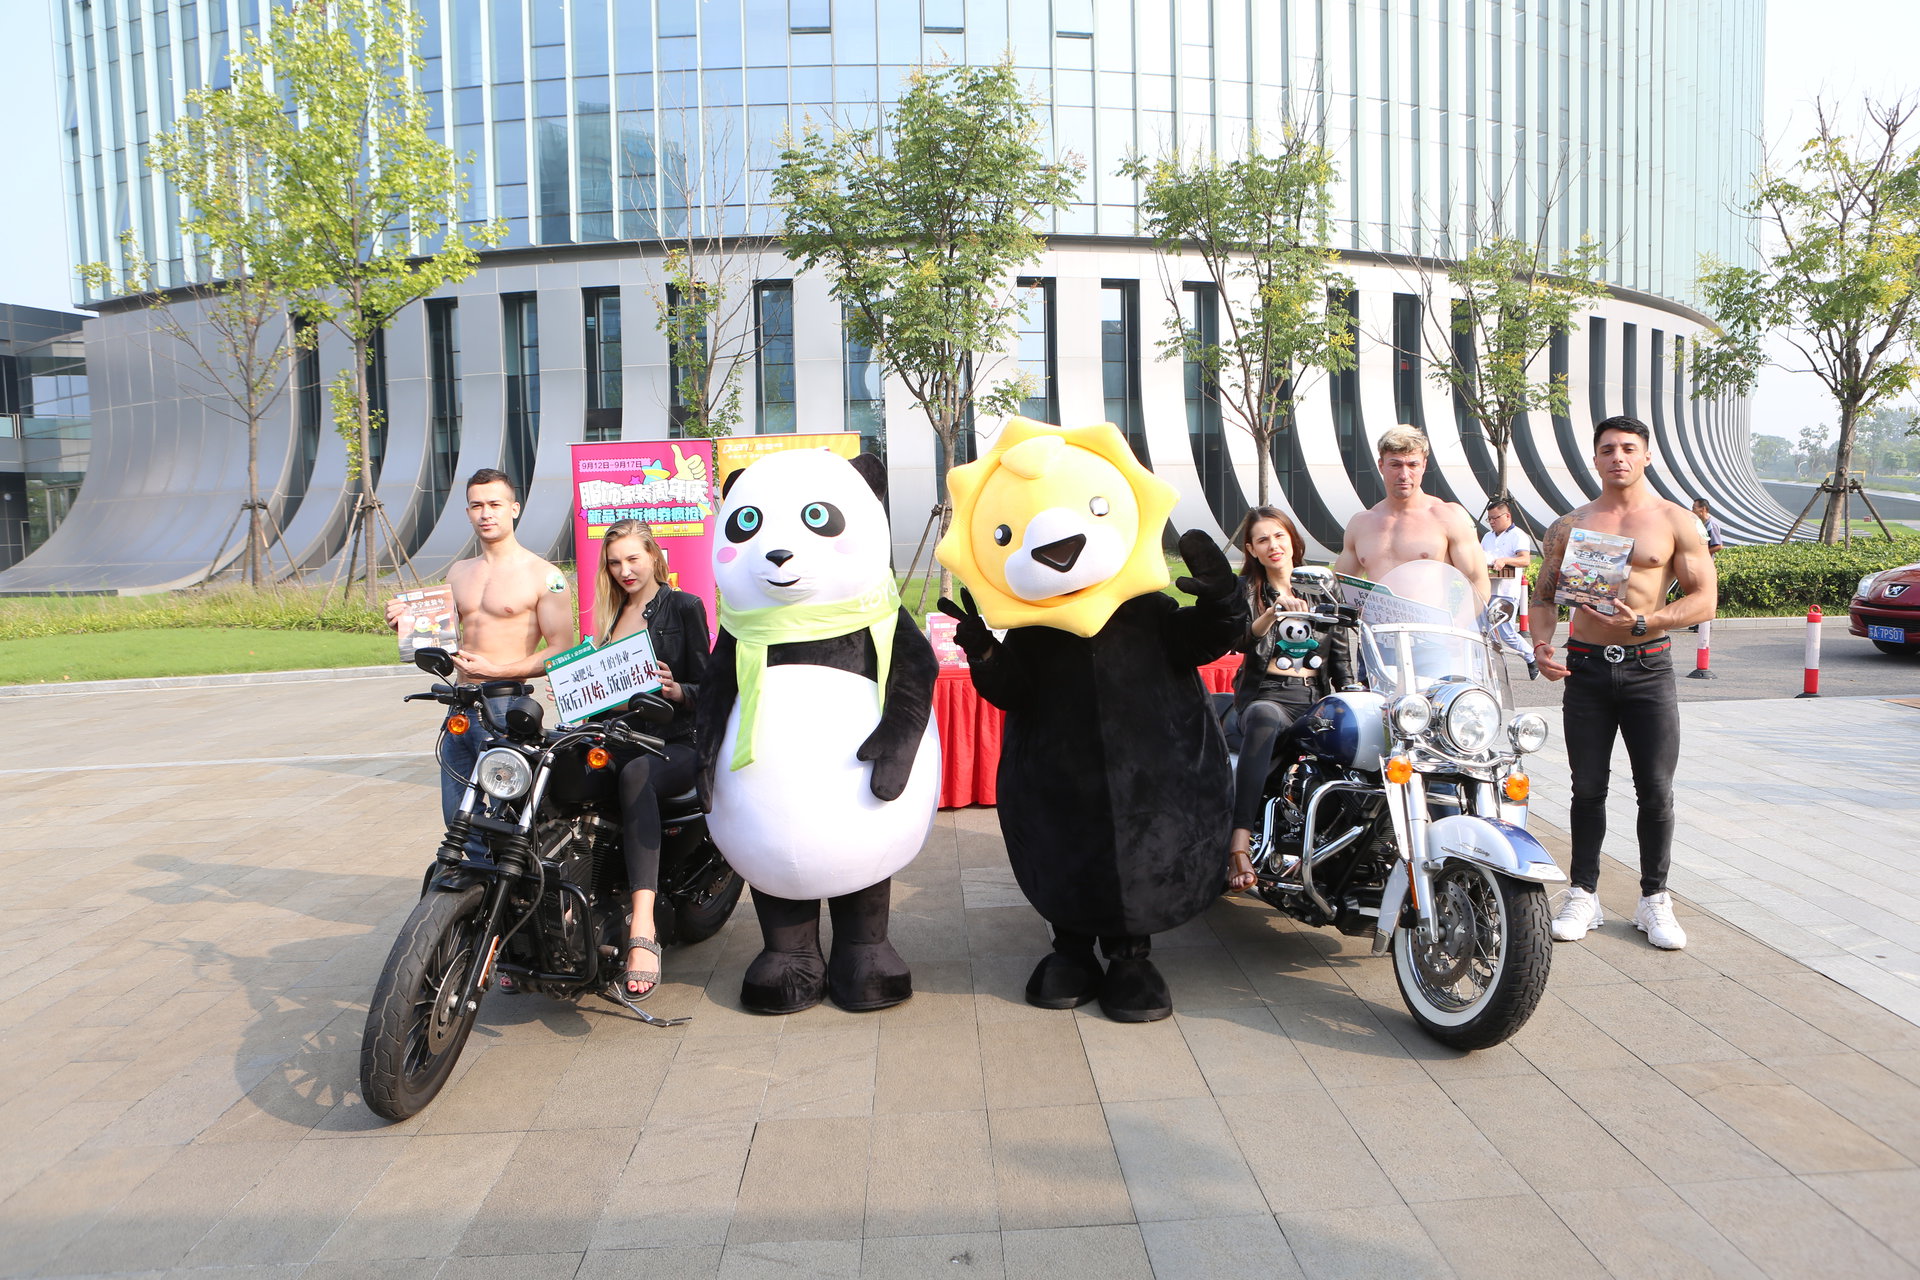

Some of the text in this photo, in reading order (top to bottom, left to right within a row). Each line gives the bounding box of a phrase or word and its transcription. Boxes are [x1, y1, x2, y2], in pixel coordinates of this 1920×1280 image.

[581, 460, 642, 470] 9月12日-9月17日
[587, 506, 700, 525] 新品五折神券疯抢
